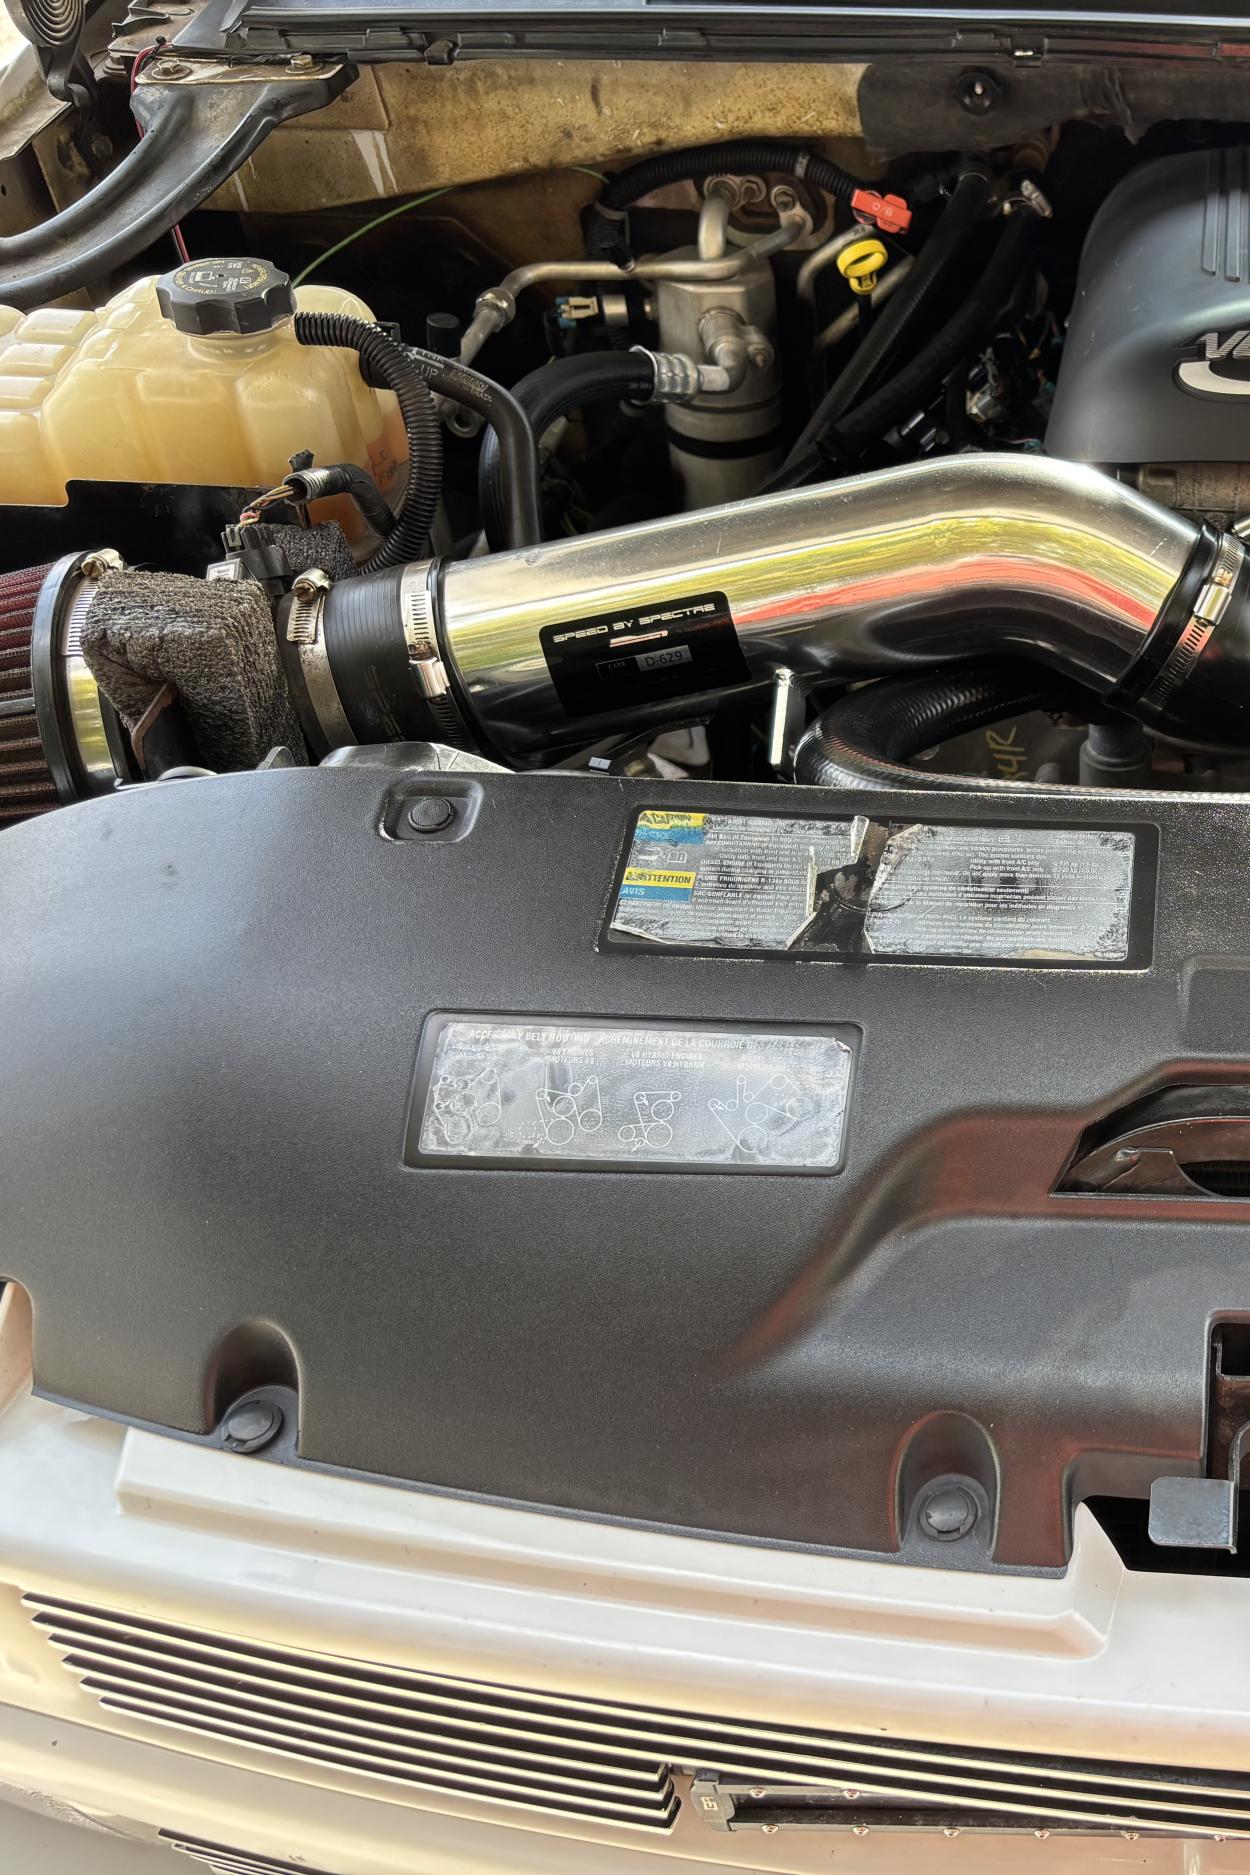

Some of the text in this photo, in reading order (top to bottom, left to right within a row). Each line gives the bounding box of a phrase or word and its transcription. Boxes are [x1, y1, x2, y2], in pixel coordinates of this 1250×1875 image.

[553, 603, 716, 643] SPEED BY SPECTRE
[645, 650, 683, 668] D-629
[639, 873, 691, 884] TTENTION
[622, 887, 646, 896] AVIS
[525, 1032, 546, 1042] BELT
[671, 1037, 684, 1047] DE
[685, 1039, 697, 1048] LA
